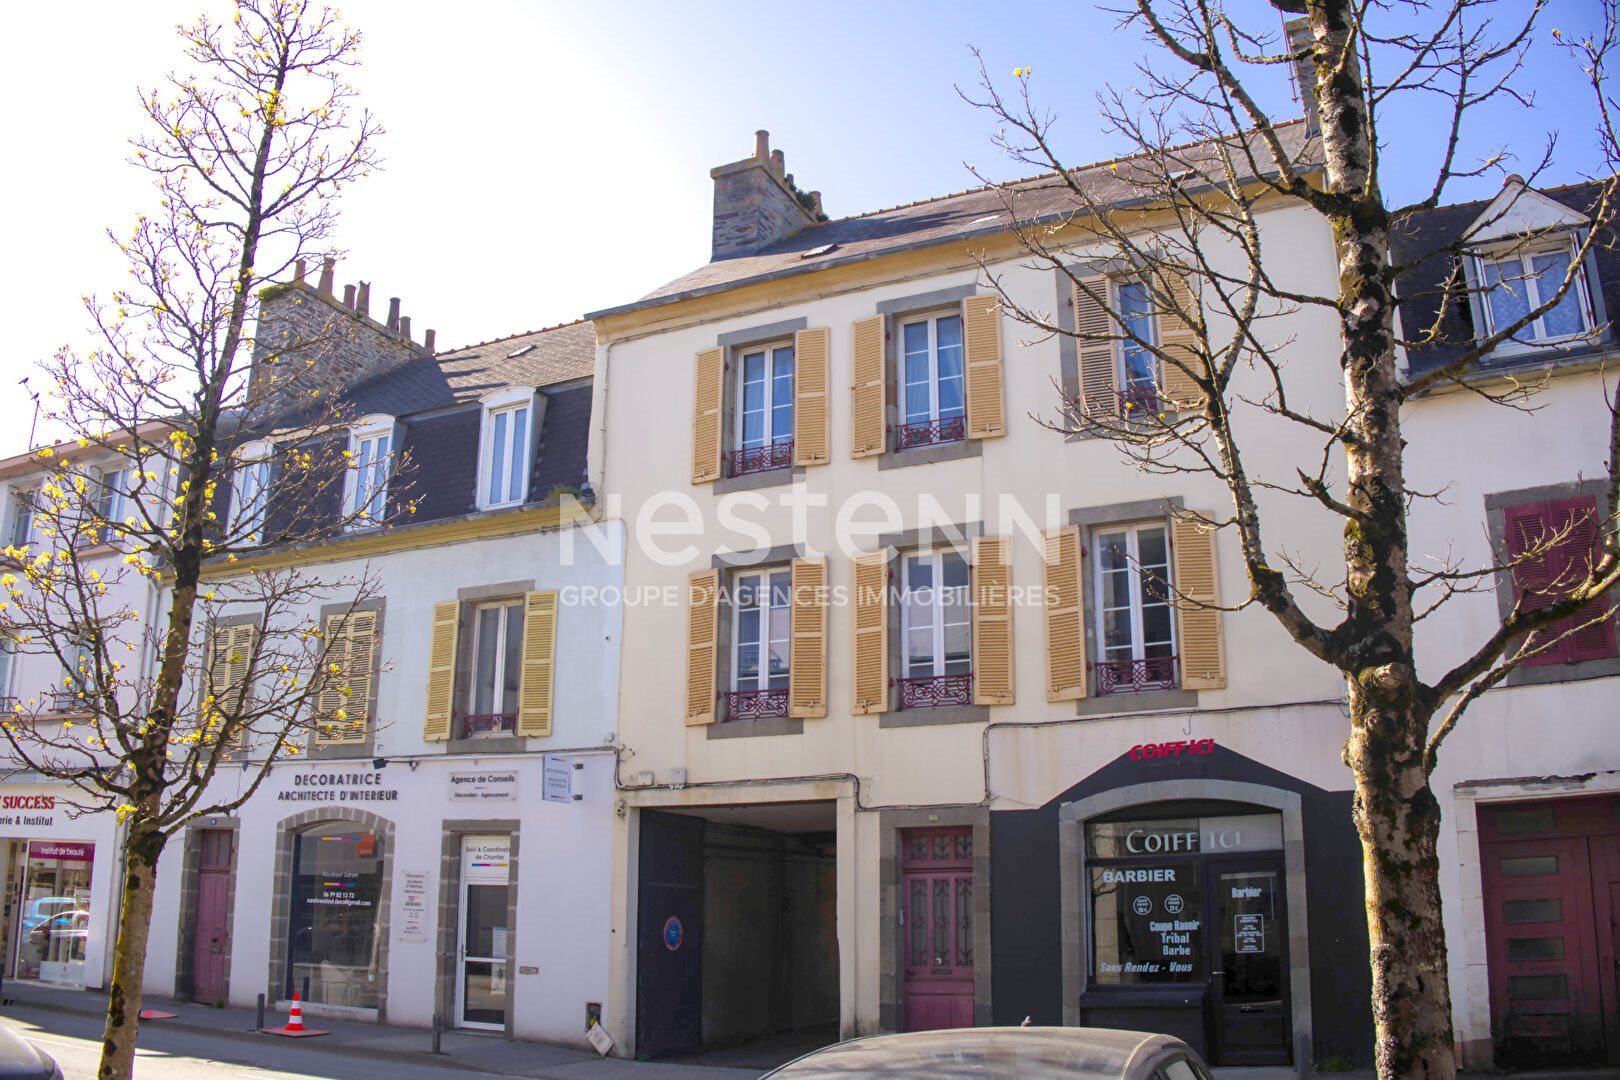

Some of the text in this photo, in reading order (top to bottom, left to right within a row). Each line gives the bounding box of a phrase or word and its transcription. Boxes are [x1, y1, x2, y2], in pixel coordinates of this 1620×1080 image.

[1129, 738, 1215, 761] COIFF ICI
[294, 773, 382, 786] DECORATRICE
[450, 776, 476, 784] Agence
[488, 775, 515, 783] Conseils
[277, 790, 335, 801] ARCHITECTE
[2, 795, 55, 810] SUCCESS
[15, 815, 21, 826] &
[23, 815, 53, 826] Institut
[1102, 868, 1176, 883] BARBIER
[1231, 887, 1262, 899] Barbier
[1149, 920, 1200, 932] Coupe Rasoir
[1160, 932, 1190, 944] Tribal
[1162, 945, 1191, 956] Barbe
[1099, 962, 1122, 973] Sans
[1124, 962, 1160, 973] Rendez
[1169, 961, 1193, 973] Vous
